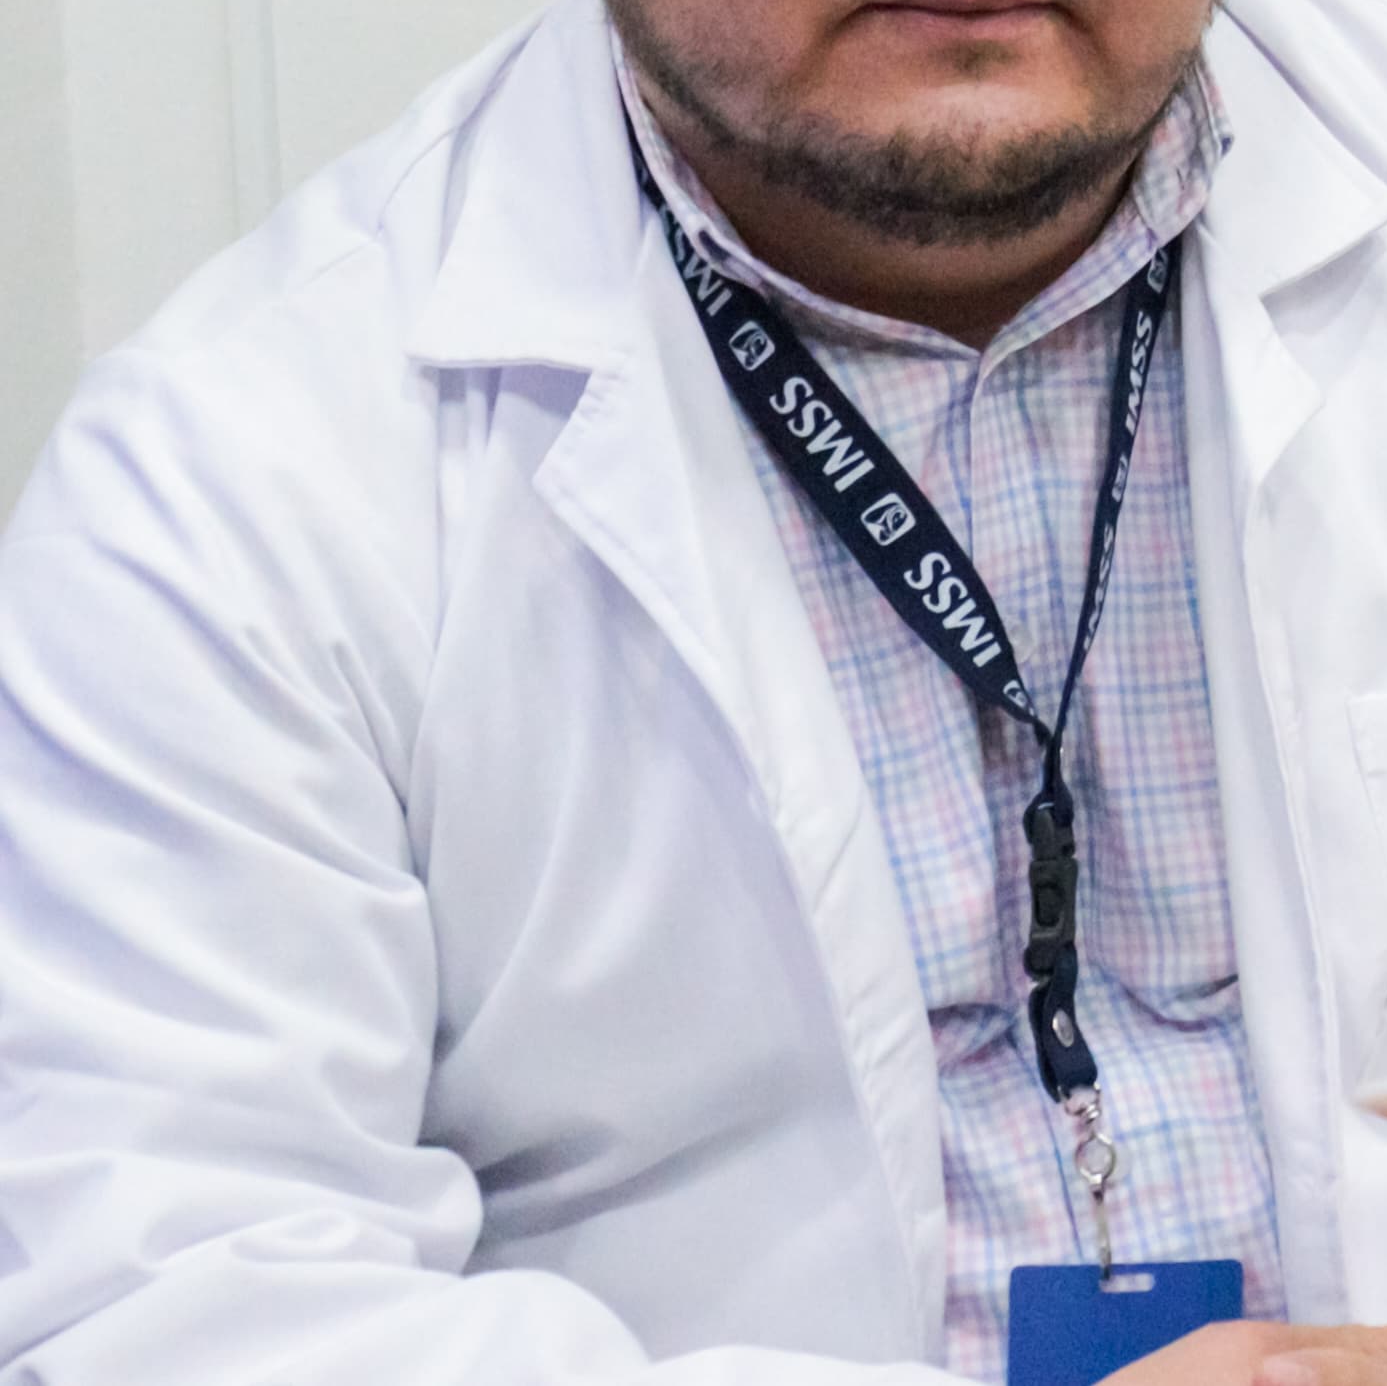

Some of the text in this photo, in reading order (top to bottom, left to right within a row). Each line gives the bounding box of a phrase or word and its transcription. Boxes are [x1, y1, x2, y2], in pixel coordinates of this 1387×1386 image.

[1126, 311, 1153, 436] IMSS
[769, 376, 875, 493] IMSS
[903, 552, 1002, 668] IMSS
